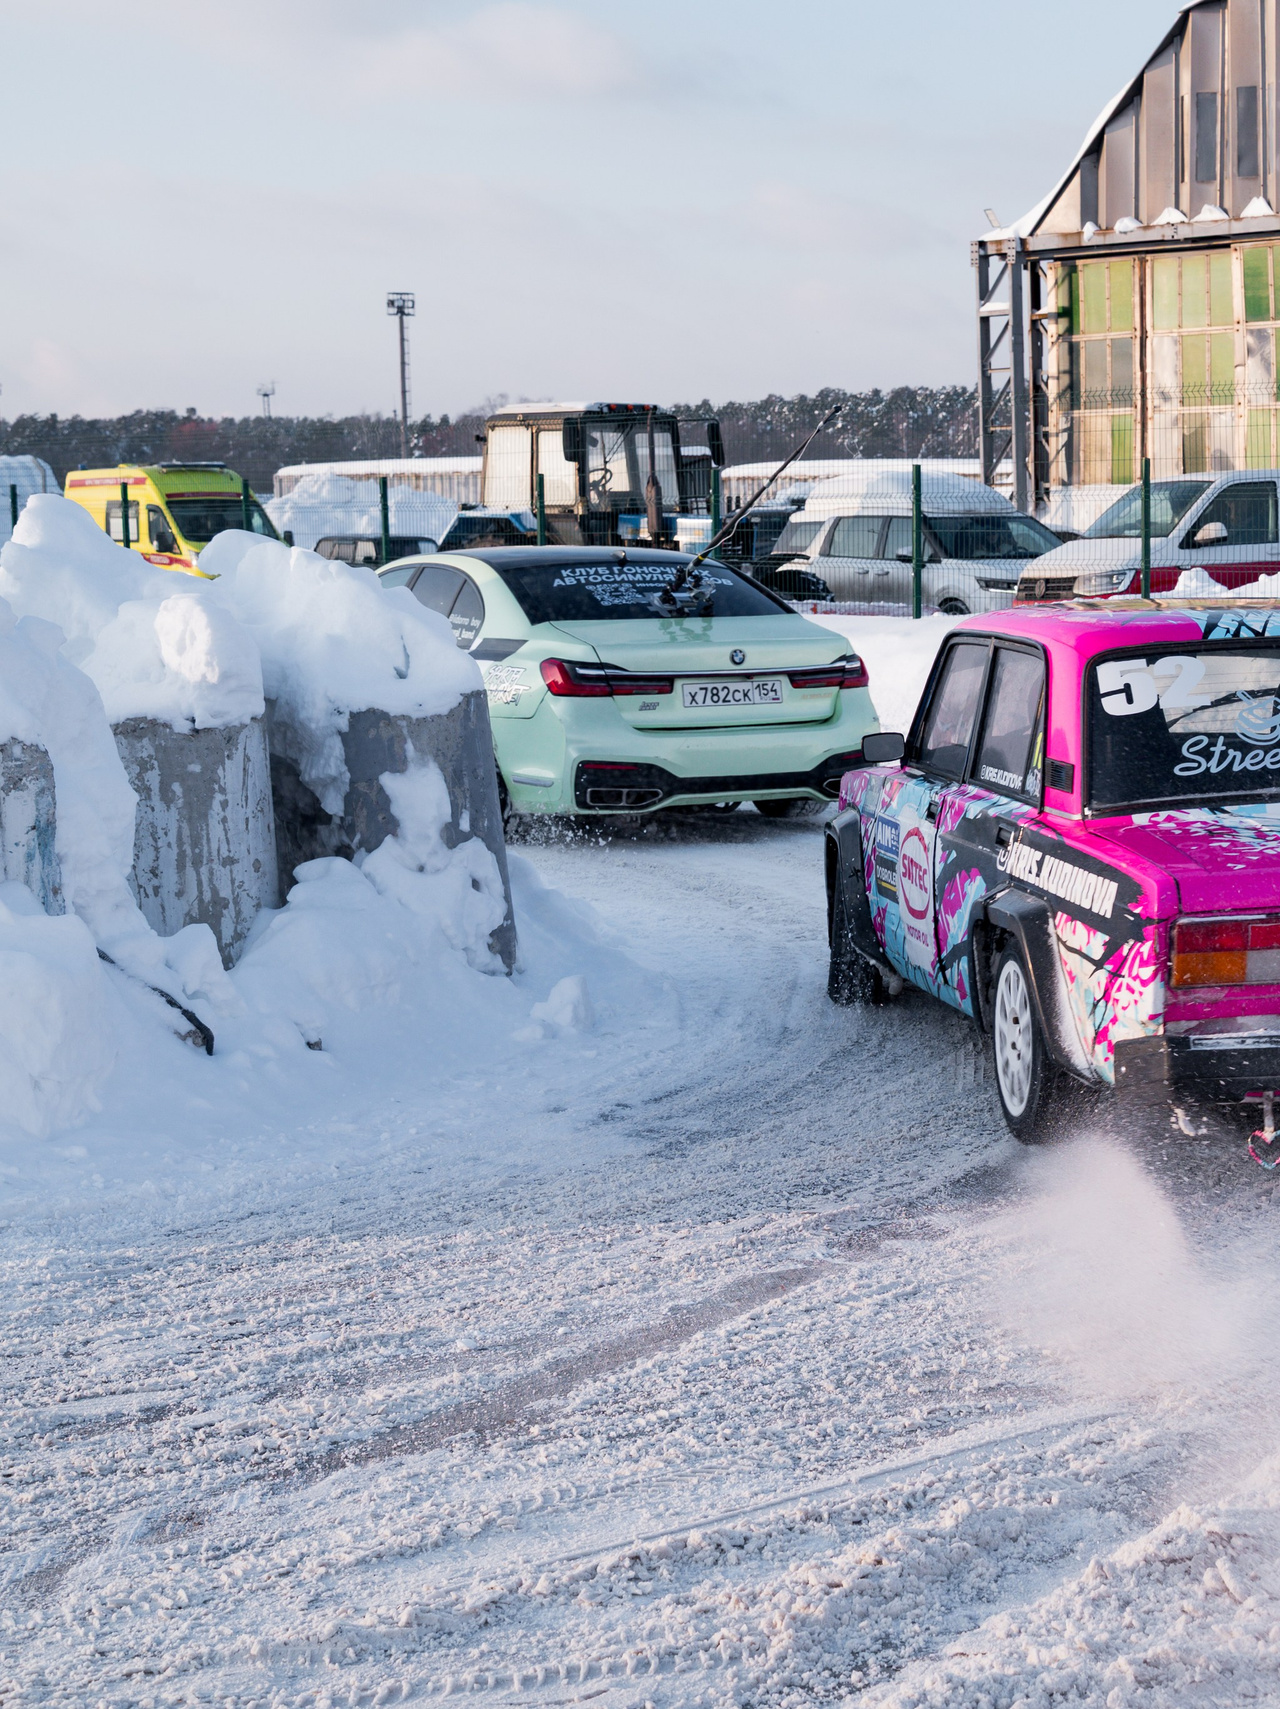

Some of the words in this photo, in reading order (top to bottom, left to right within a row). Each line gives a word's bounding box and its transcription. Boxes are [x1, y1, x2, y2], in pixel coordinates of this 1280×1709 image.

[560, 567, 610, 577] КЛУБ
[612, 566, 713, 577] ГОНОЧХ
[754, 682, 778, 697] 154
[1096, 655, 1212, 717] 52
[876, 821, 892, 848] AIM
[996, 841, 1119, 919] @KRIS.KUDINOVA
[921, 931, 930, 947] OIL
